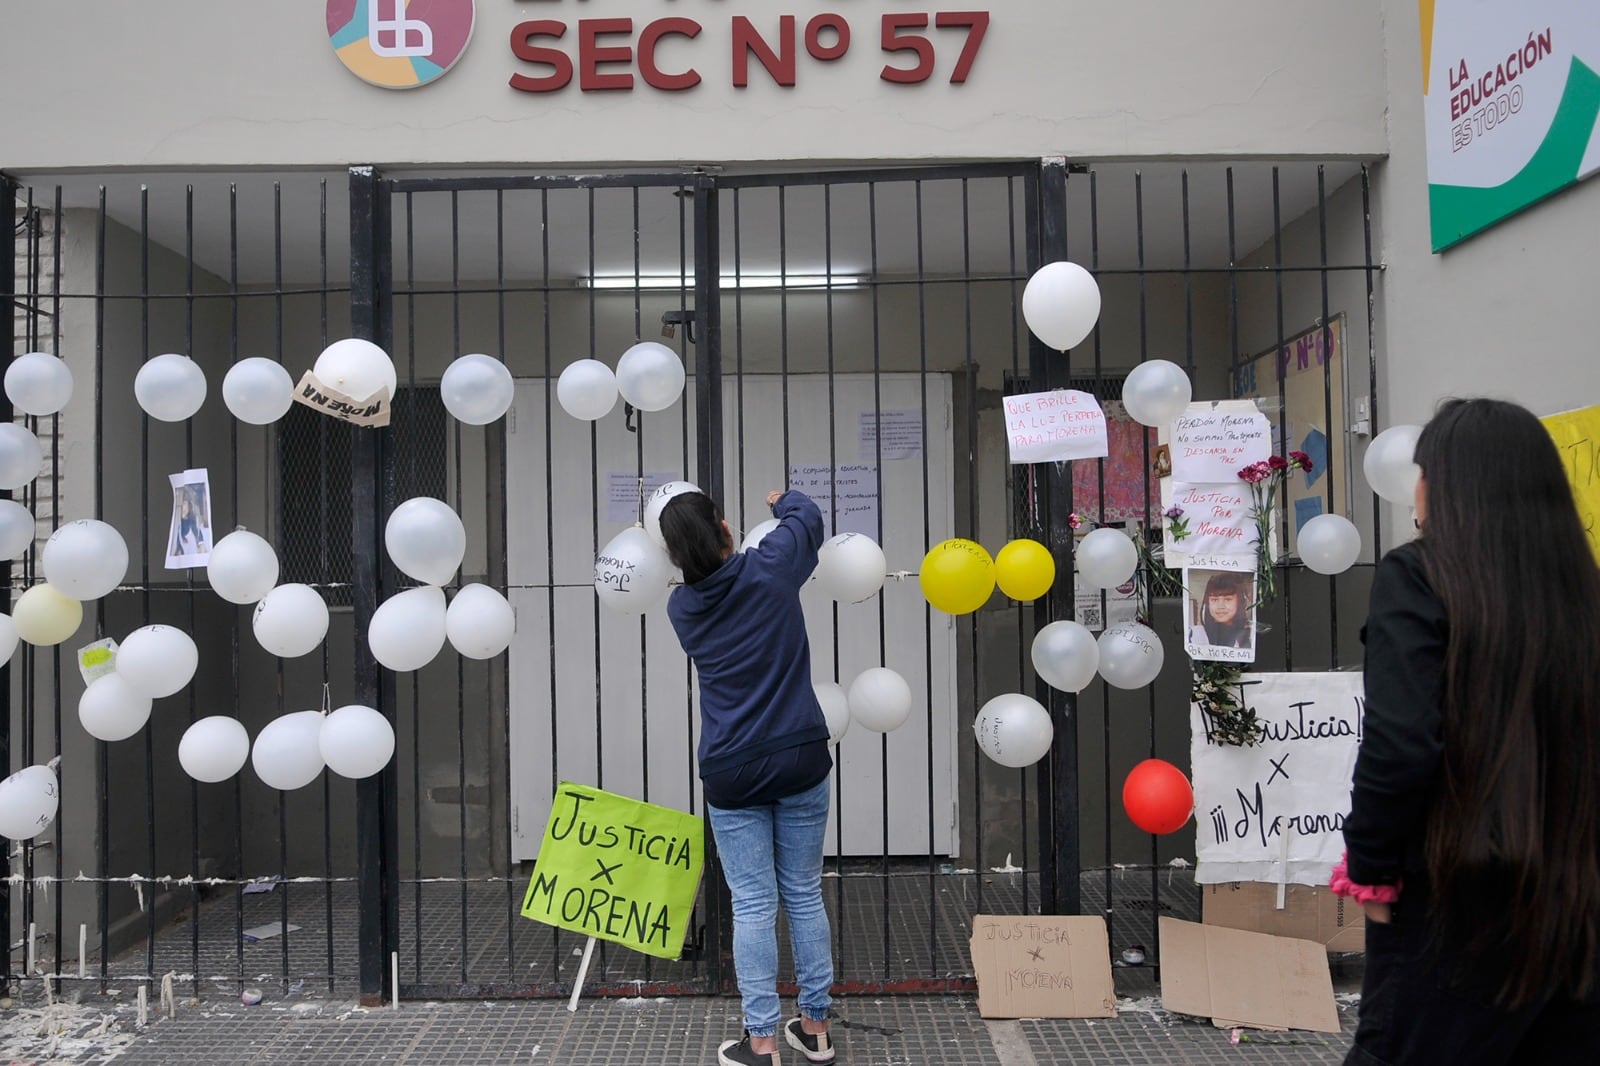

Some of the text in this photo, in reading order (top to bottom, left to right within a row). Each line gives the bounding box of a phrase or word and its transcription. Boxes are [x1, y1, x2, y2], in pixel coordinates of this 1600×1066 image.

[508, 18, 702, 93] SEC
[879, 11, 990, 84] 57
[1449, 58, 1469, 91] LA
[1450, 27, 1552, 121] EDUCACIÓN
[1452, 84, 1524, 152] ES TODO
[302, 384, 381, 417] MORENA
[1008, 396, 1078, 415] QUE BRILLE
[1011, 420, 1026, 431] LA
[1032, 416, 1056, 428] LUZ
[1221, 415, 1254, 431] MORENA
[1014, 433, 1044, 448] PARA
[1184, 447, 1244, 457] DESCANSA EN
[1183, 488, 1241, 505] JUSTICIA
[1196, 521, 1243, 540] MORENA
[1209, 648, 1251, 659] MORENA
[590, 858, 623, 885] X
[526, 872, 671, 948] MORENA
